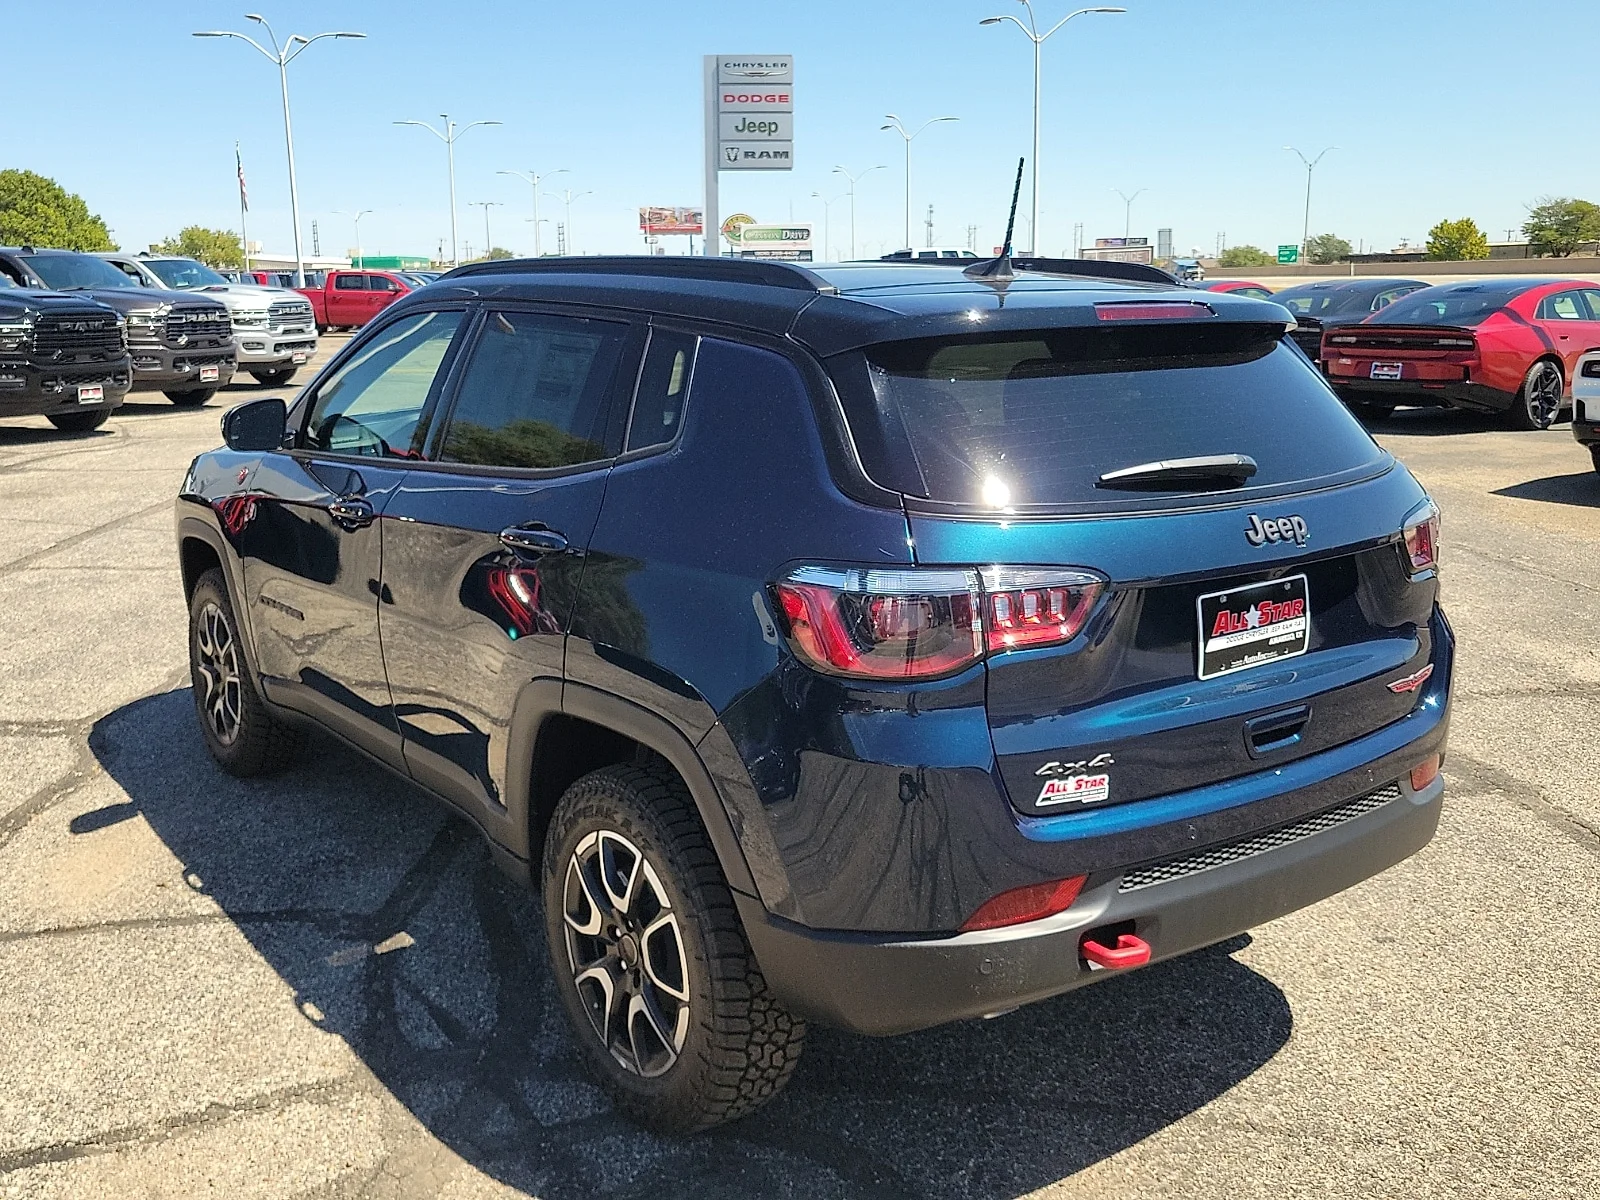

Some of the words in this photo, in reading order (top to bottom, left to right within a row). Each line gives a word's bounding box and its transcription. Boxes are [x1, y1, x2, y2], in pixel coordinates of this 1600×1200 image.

[723, 94, 789, 103] DODGE
[734, 117, 779, 137] Jeep
[743, 150, 790, 160] RAM
[782, 230, 810, 240] DRIVE
[185, 313, 221, 323] RAM
[59, 321, 105, 332] RAM
[1245, 513, 1309, 547] Jeep
[1212, 610, 1248, 636] ALL
[1258, 599, 1304, 625] STAR
[1044, 782, 1068, 796] ALL
[1074, 778, 1106, 791] STAR
